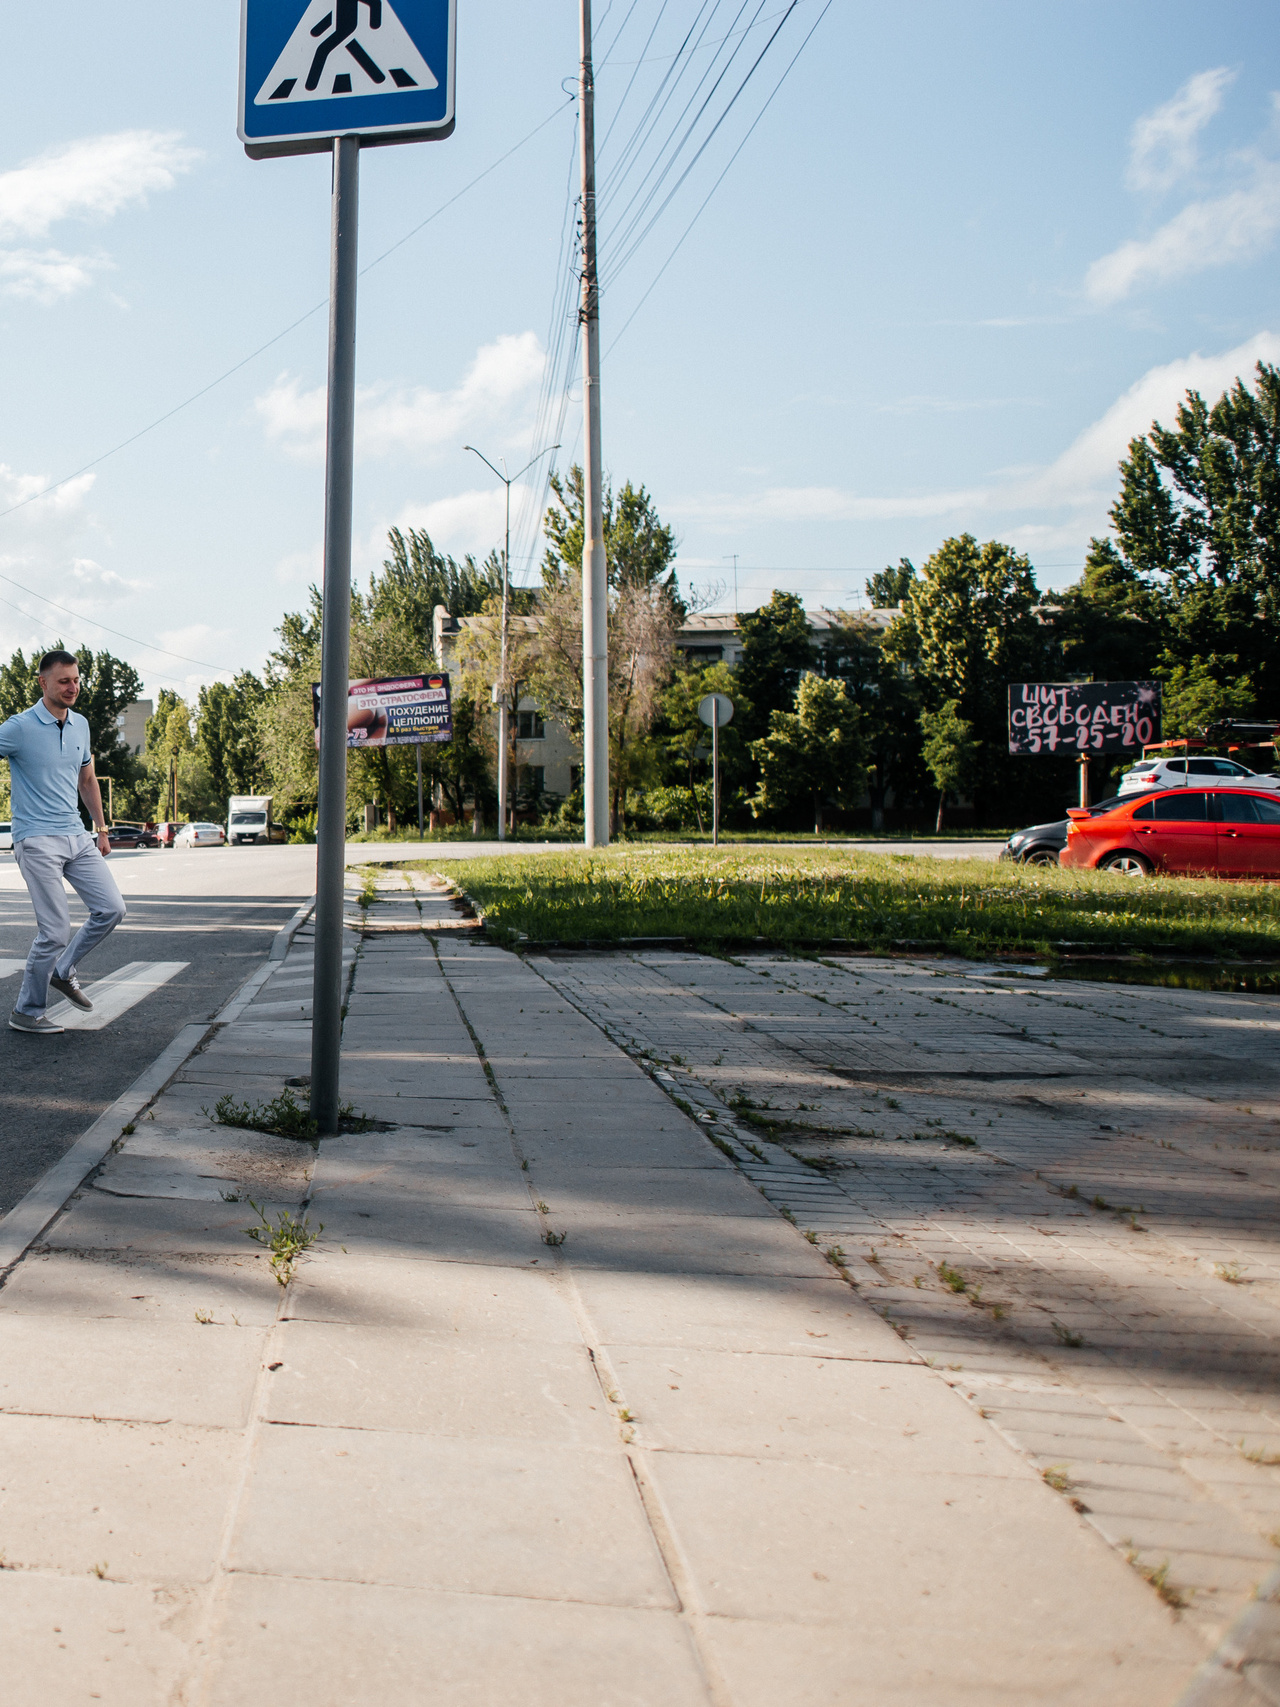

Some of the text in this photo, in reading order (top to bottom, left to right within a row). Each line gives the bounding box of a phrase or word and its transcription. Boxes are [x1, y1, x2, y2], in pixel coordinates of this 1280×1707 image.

[353, 687, 366, 695] ЭТО
[360, 690, 444, 708] ЭТО СТРАТОСФЕРА
[1022, 684, 1070, 708] ЩИТ
[389, 704, 449, 717] ПОХУДЕНИЕ
[1011, 702, 1138, 729] СВОБОДЕН
[393, 715, 449, 727] ЦЕЛЛЮЛИТ
[1028, 717, 1153, 753] 57-25-20
